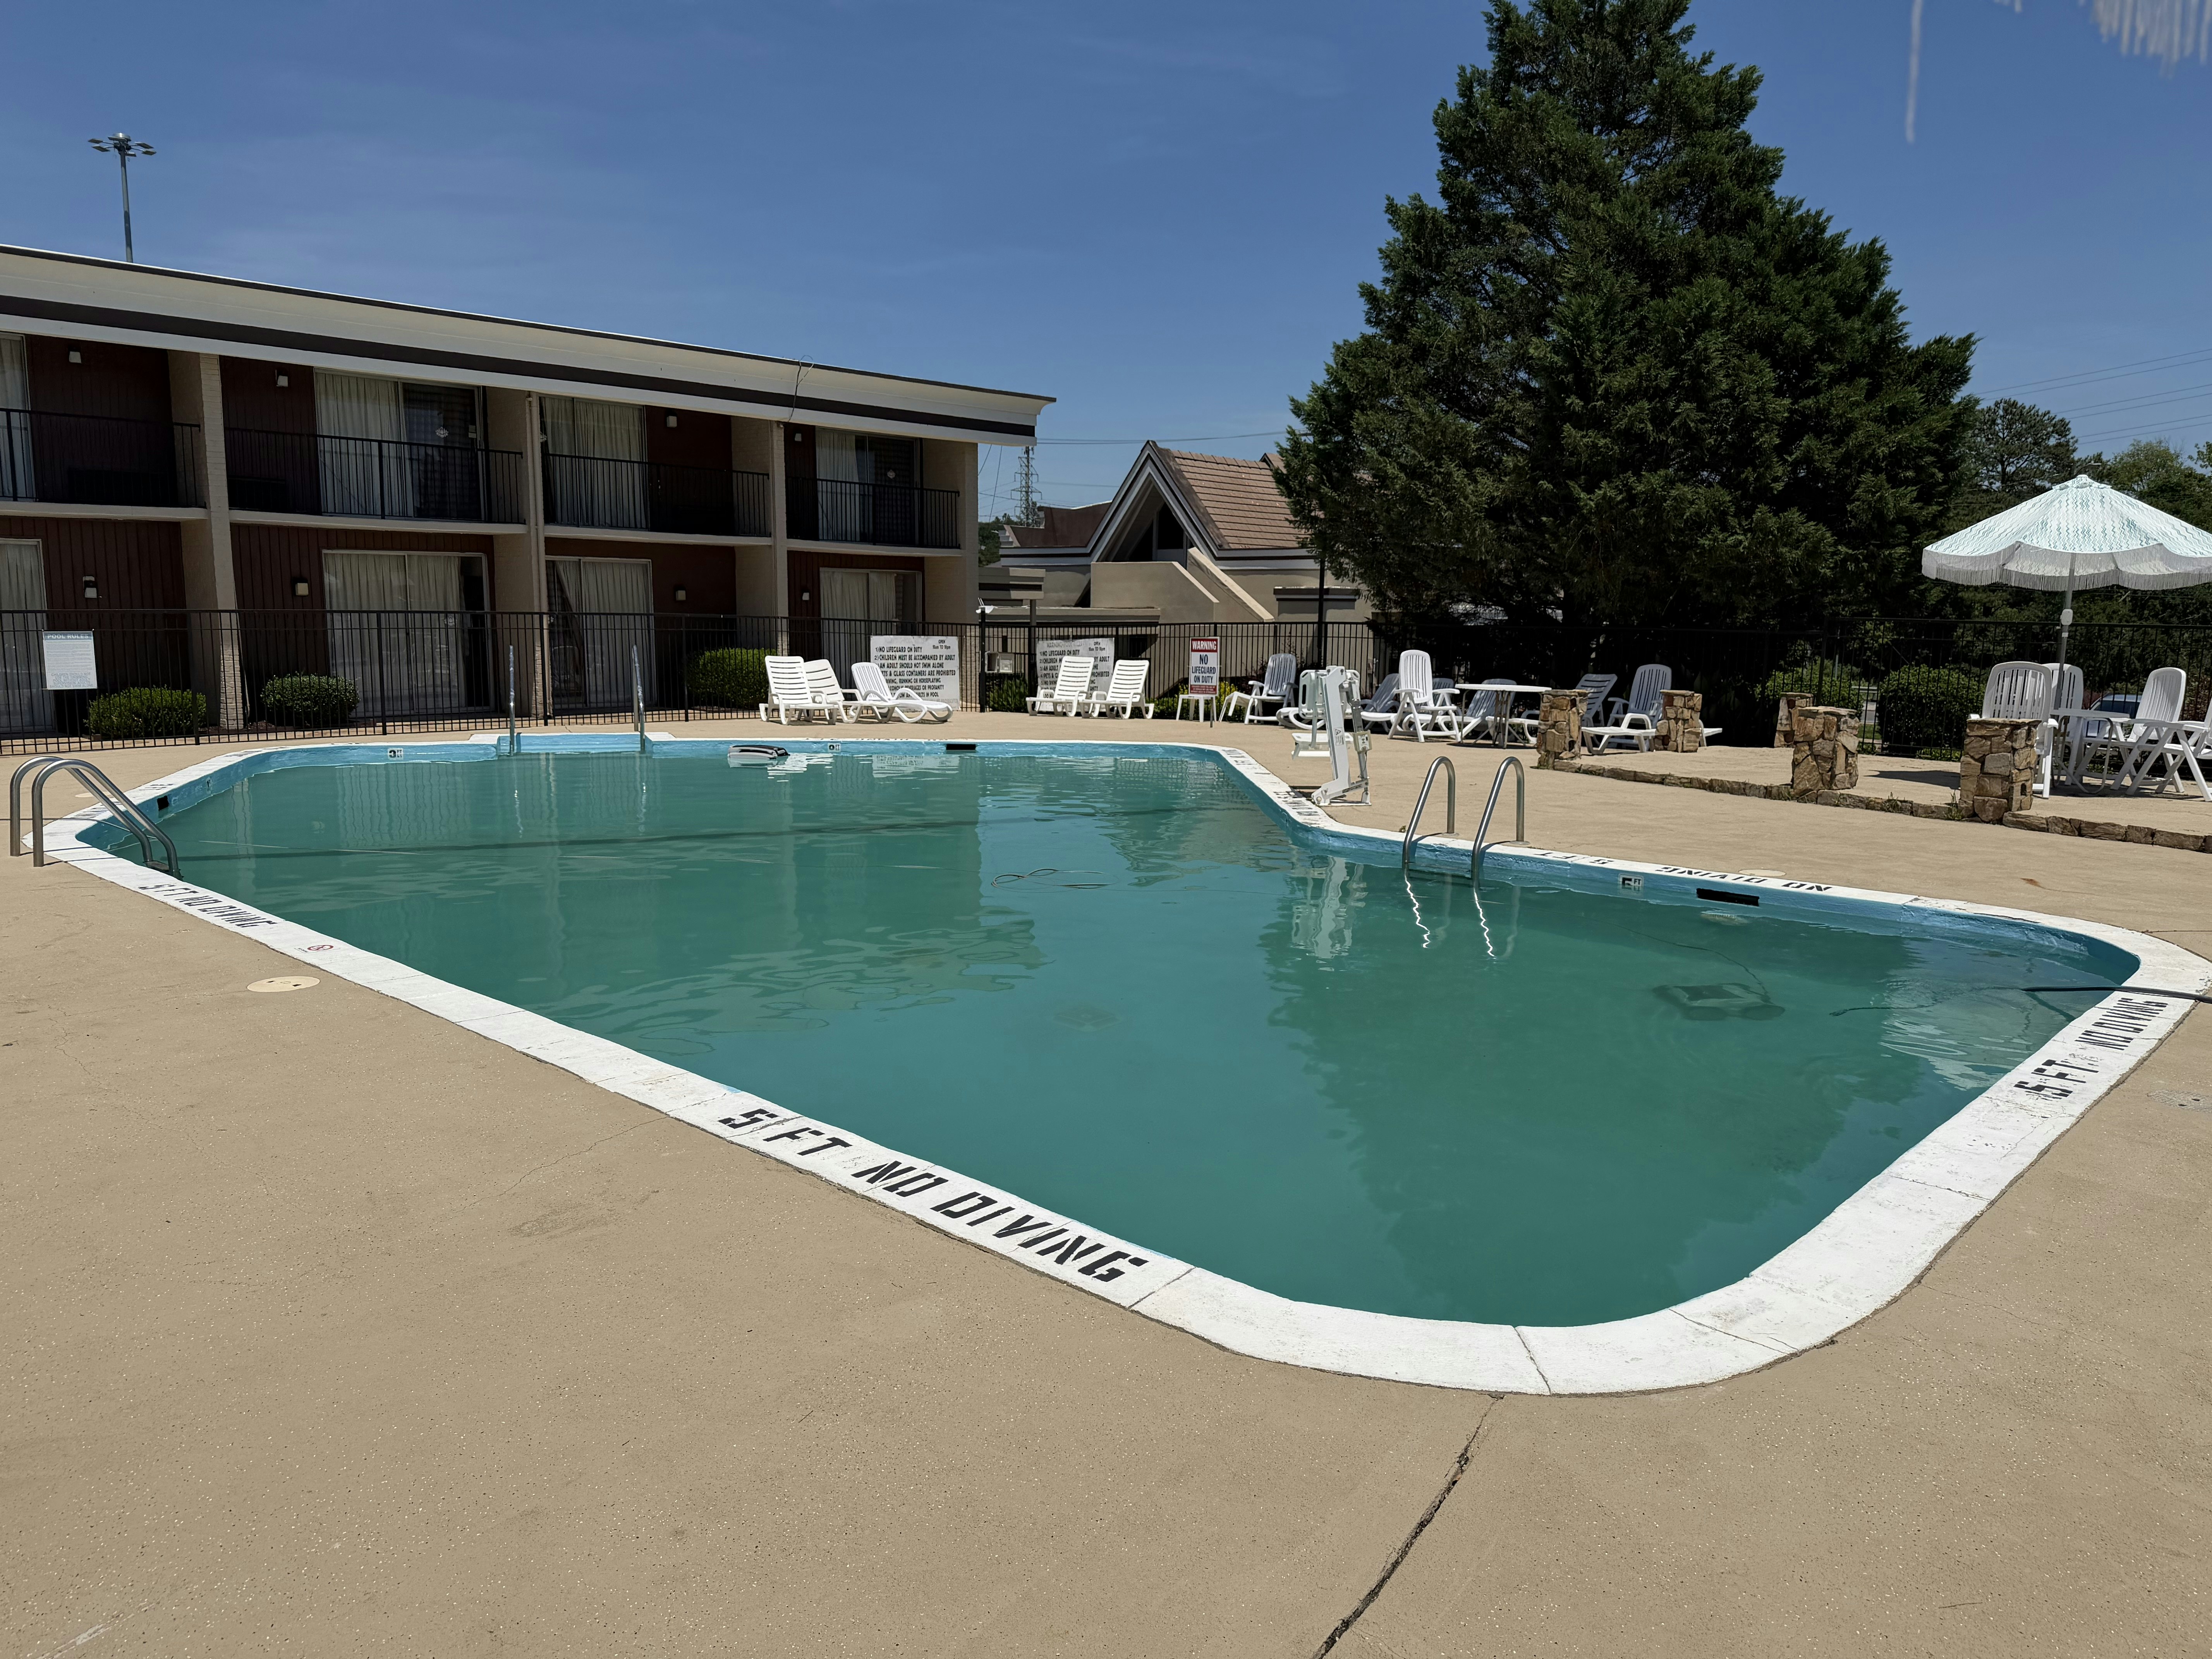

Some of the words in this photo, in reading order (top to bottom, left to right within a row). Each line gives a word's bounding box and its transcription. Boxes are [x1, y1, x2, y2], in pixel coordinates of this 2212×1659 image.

[1192, 641, 1217, 650] WARNING
[1199, 654, 1208, 665] NO
[1192, 666, 1216, 675] LIFEGUARD
[1194, 675, 1200, 683] ON
[1201, 675, 1214, 684] DUTY
[1655, 867, 1768, 883] DIVING
[153, 888, 199, 896] FT
[1781, 882, 1832, 891] NO
[174, 895, 223, 906] NO
[197, 905, 278, 927] DIVING
[2092, 997, 2168, 1033] DIVING
[2074, 1030, 2134, 1050] NO
[2031, 1059, 2099, 1084] FT
[2013, 1080, 2073, 1097] 5
[718, 1108, 779, 1129] 5
[763, 1127, 852, 1156] FT
[852, 1160, 948, 1197] NO
[930, 1191, 1150, 1283] DIVING
